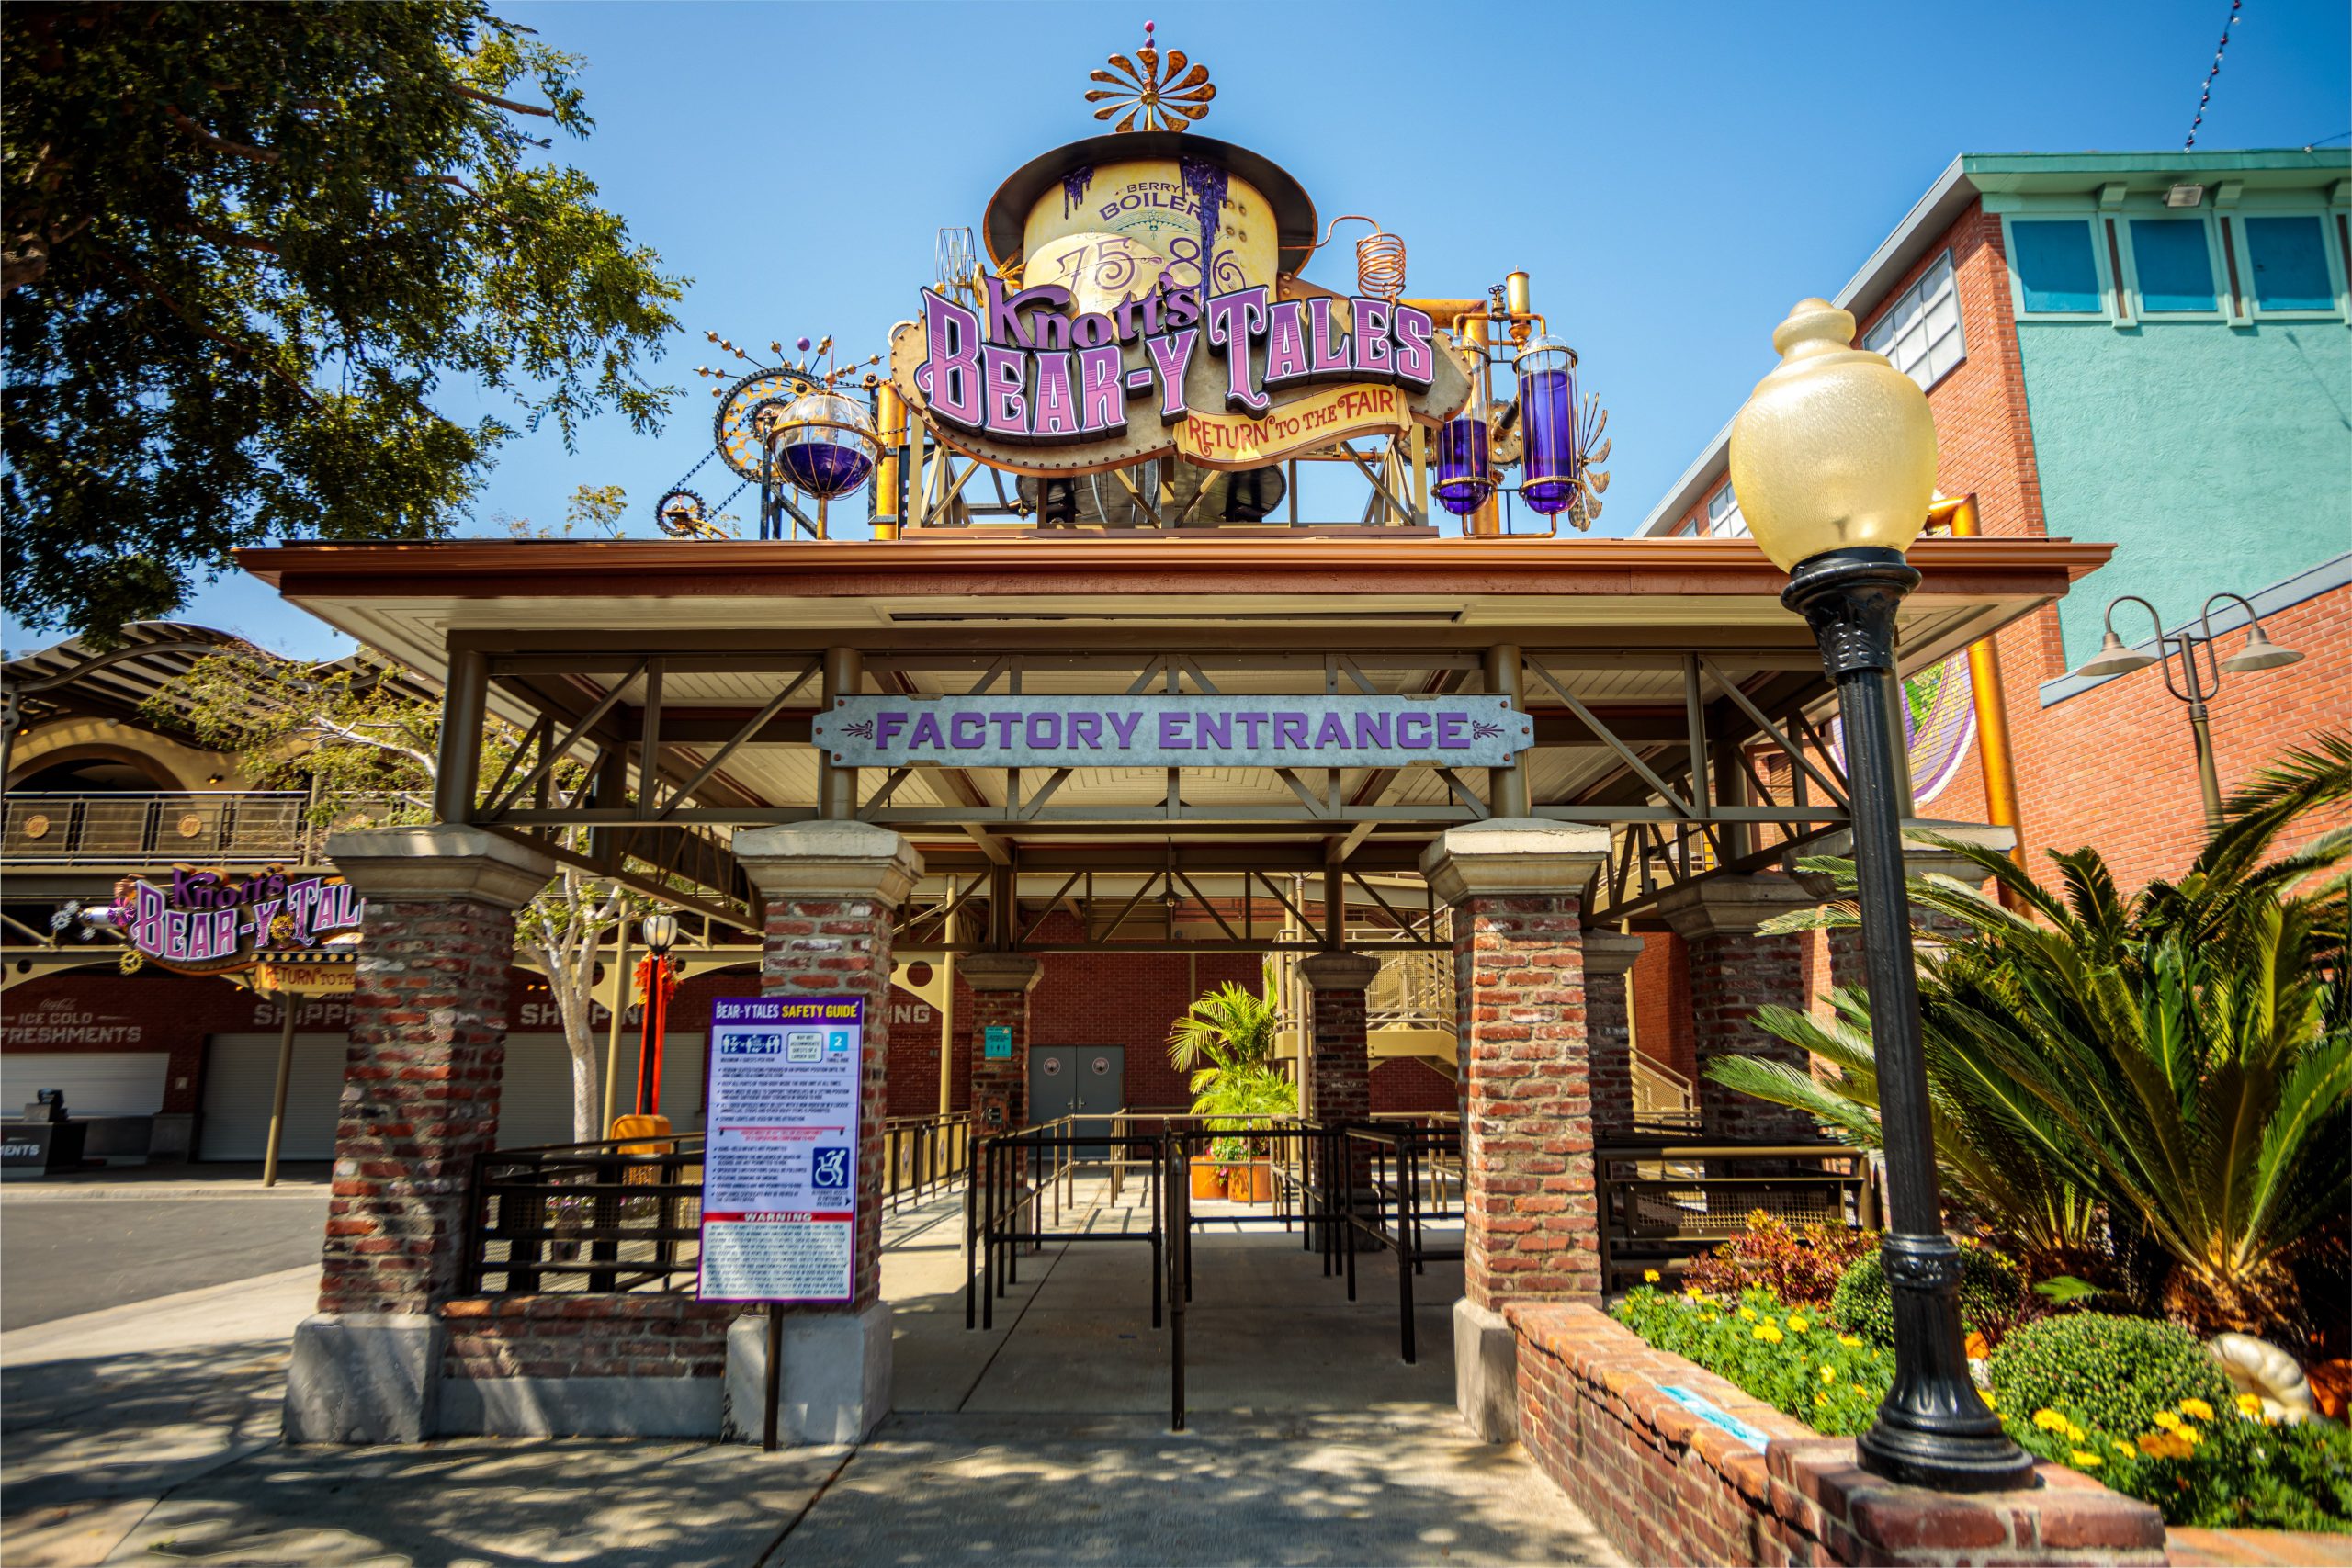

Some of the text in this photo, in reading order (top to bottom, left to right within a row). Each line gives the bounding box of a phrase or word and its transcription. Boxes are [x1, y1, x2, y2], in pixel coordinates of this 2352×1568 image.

[1126, 182, 1182, 193] BERRY
[1099, 192, 1203, 221] BOILER
[984, 272, 1200, 350] Knott's
[914, 285, 1435, 437] BEAR-Y TALES
[1188, 389, 1395, 457] RETURN TO THE FAIR
[875, 711, 1472, 750] FACTORY ENTRANCE
[130, 877, 368, 961] BEAR-Y TAL
[321, 973, 335, 986] TO
[337, 972, 356, 986] TH
[18, 1012, 94, 1025] ICE COLD
[716, 1001, 860, 1020] BEAR-Y TALES SAFETY GUIDE
[833, 1037, 842, 1047] 2
[744, 1213, 814, 1223] WARNING
